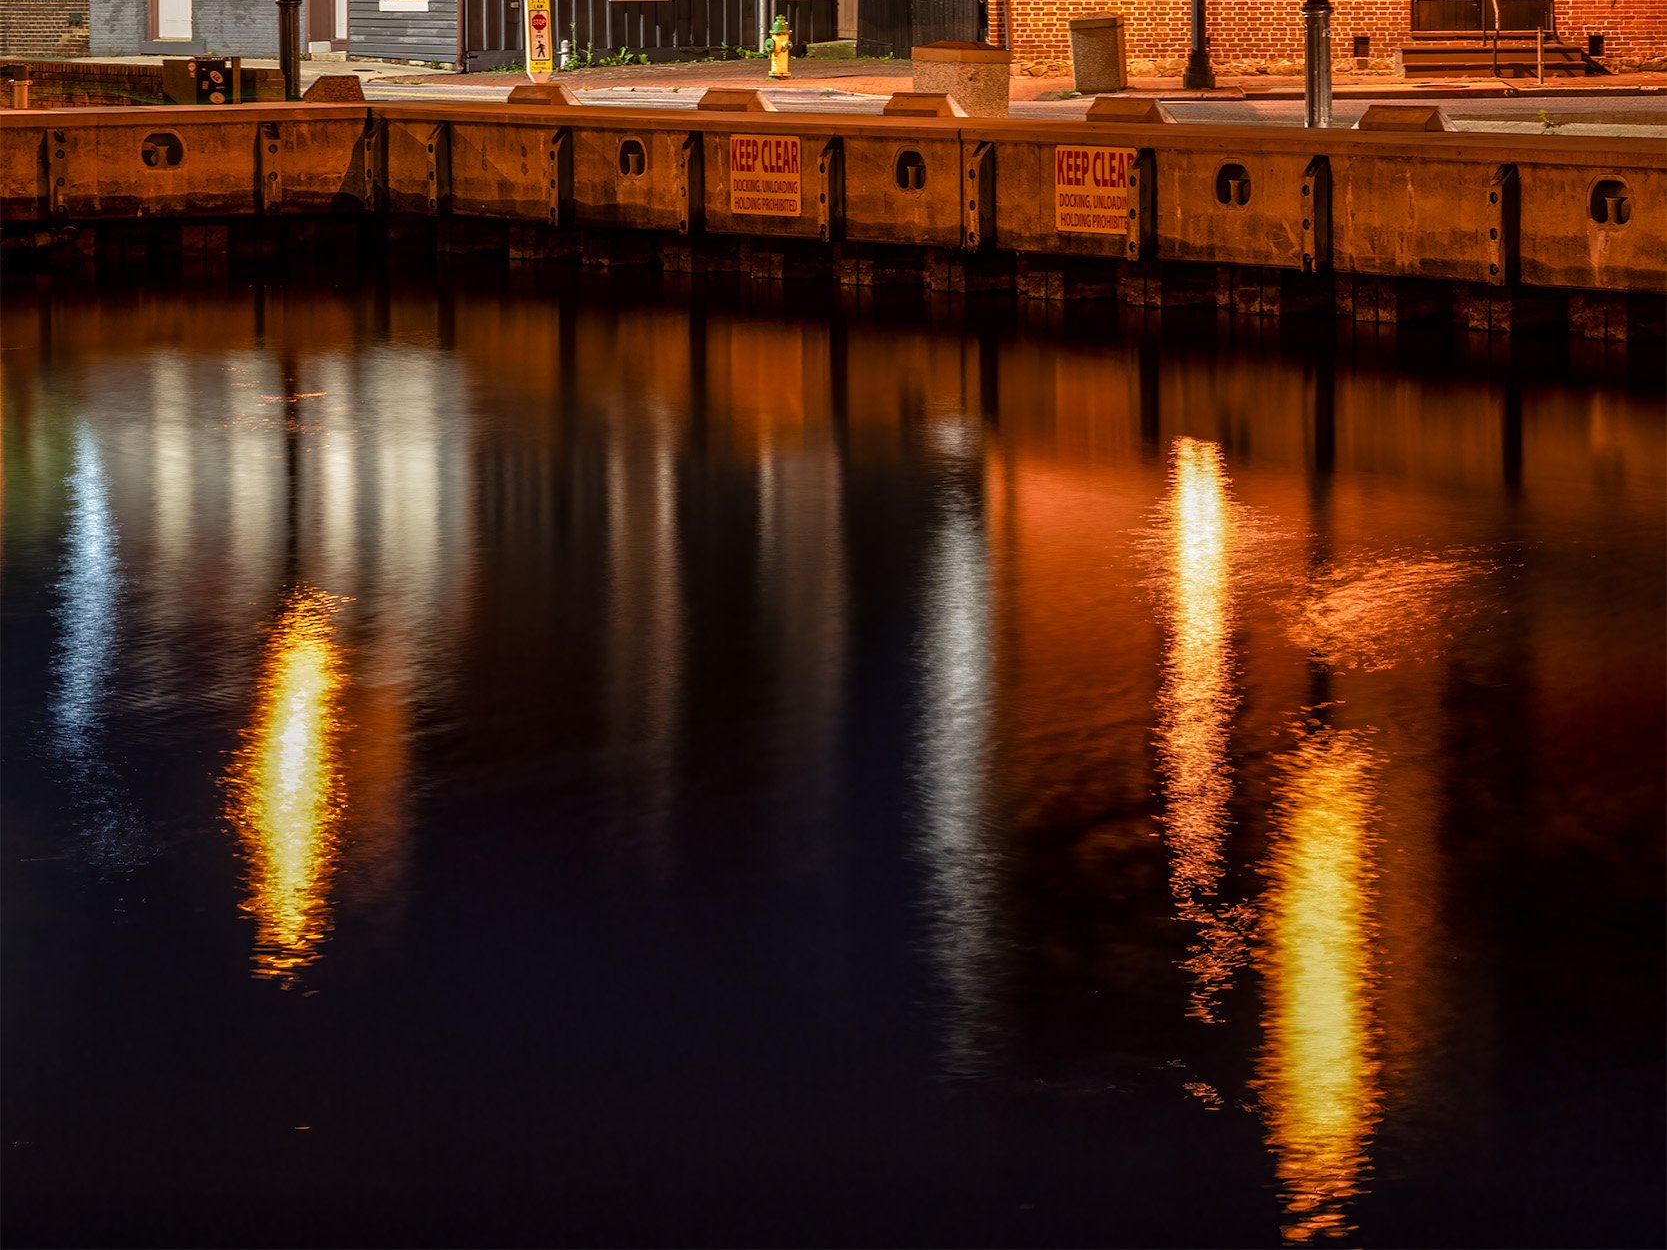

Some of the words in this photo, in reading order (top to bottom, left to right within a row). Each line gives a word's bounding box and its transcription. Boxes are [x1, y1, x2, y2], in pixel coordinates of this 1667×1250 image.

[731, 139, 758, 172] KEEP
[762, 140, 799, 173] CLEAR
[1057, 150, 1089, 186] KEEP
[762, 180, 797, 194] UNLOADING
[735, 197, 760, 210] HOLDING
[762, 197, 797, 212] PROHIBITED
[1059, 193, 1091, 210] DOCKING,
[1060, 212, 1091, 228] HOLDING
[1092, 214, 1128, 230] PROHIBITE
